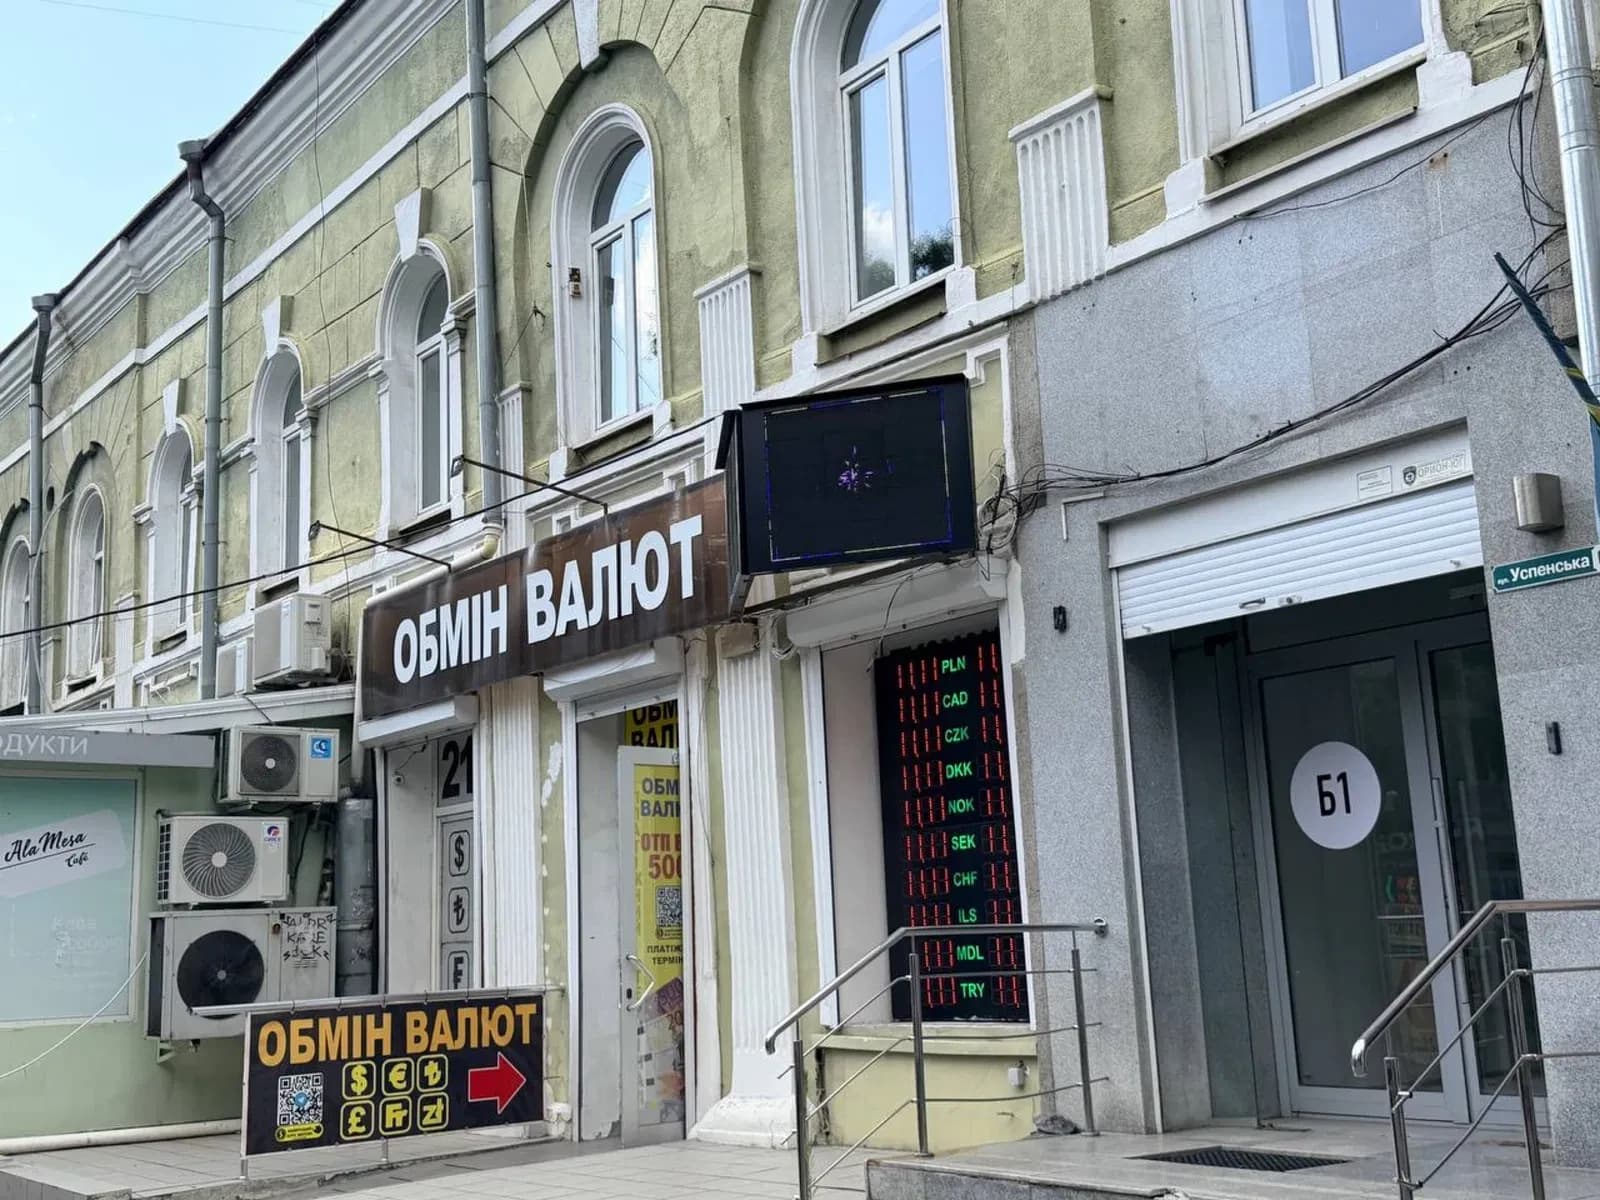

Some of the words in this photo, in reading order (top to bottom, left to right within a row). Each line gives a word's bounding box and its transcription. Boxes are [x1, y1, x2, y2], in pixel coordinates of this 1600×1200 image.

[1509, 556, 1590, 582] Успенська
[393, 584, 507, 684] ОБМІН
[526, 515, 703, 645] ВАЛЮТ
[941, 656, 966, 674] PLN
[942, 691, 969, 708] CAD
[632, 724, 679, 748] ВАЛ
[944, 726, 970, 743] CZK
[945, 762, 973, 779] DKK
[1316, 771, 1351, 817] Б1
[640, 800, 681, 817] ВАЛ
[948, 798, 975, 813] NOK
[4, 839, 39, 862] Ala
[39, 831, 87, 852] Mesa
[951, 834, 977, 850] SEK
[953, 871, 978, 887] CHF
[958, 908, 977, 923] ILS
[956, 946, 984, 961] MDL
[960, 982, 985, 998] TRY
[258, 1012, 392, 1067] ОБМІН
[406, 1003, 537, 1055] ВАЛЮТ
